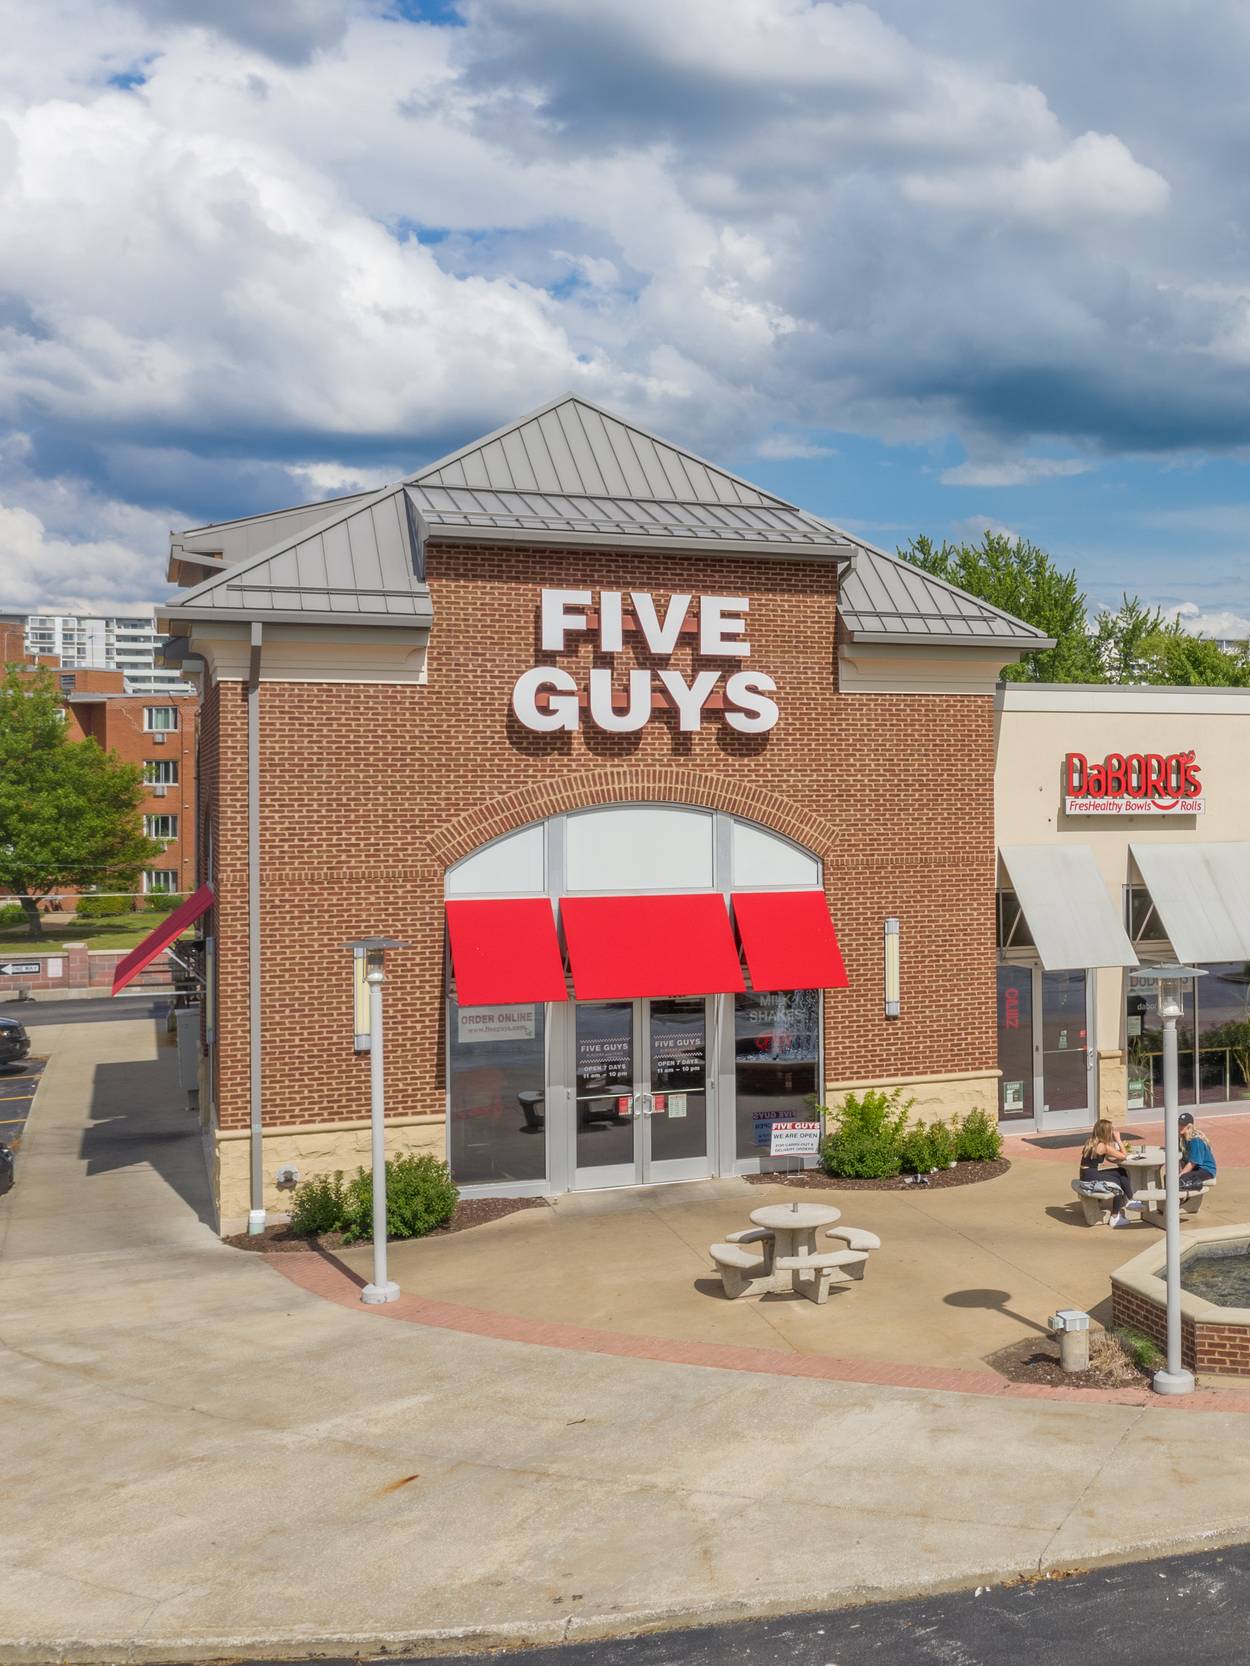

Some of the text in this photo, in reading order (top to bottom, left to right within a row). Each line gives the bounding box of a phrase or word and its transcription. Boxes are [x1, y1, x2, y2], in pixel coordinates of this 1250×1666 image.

[540, 588, 751, 657] FIVE
[512, 666, 780, 734] GUYS
[1069, 800, 1202, 814] FresHealthy Bowls Rolls
[461, 1012, 533, 1025] ORDER ONLINE
[749, 1009, 805, 1023] SHAKES
[581, 1043, 629, 1052] FIVE GUYS
[655, 1038, 701, 1048] FIVE GUYS
[772, 1122, 793, 1130] FIVE
[794, 1121, 820, 1130] GUYS
